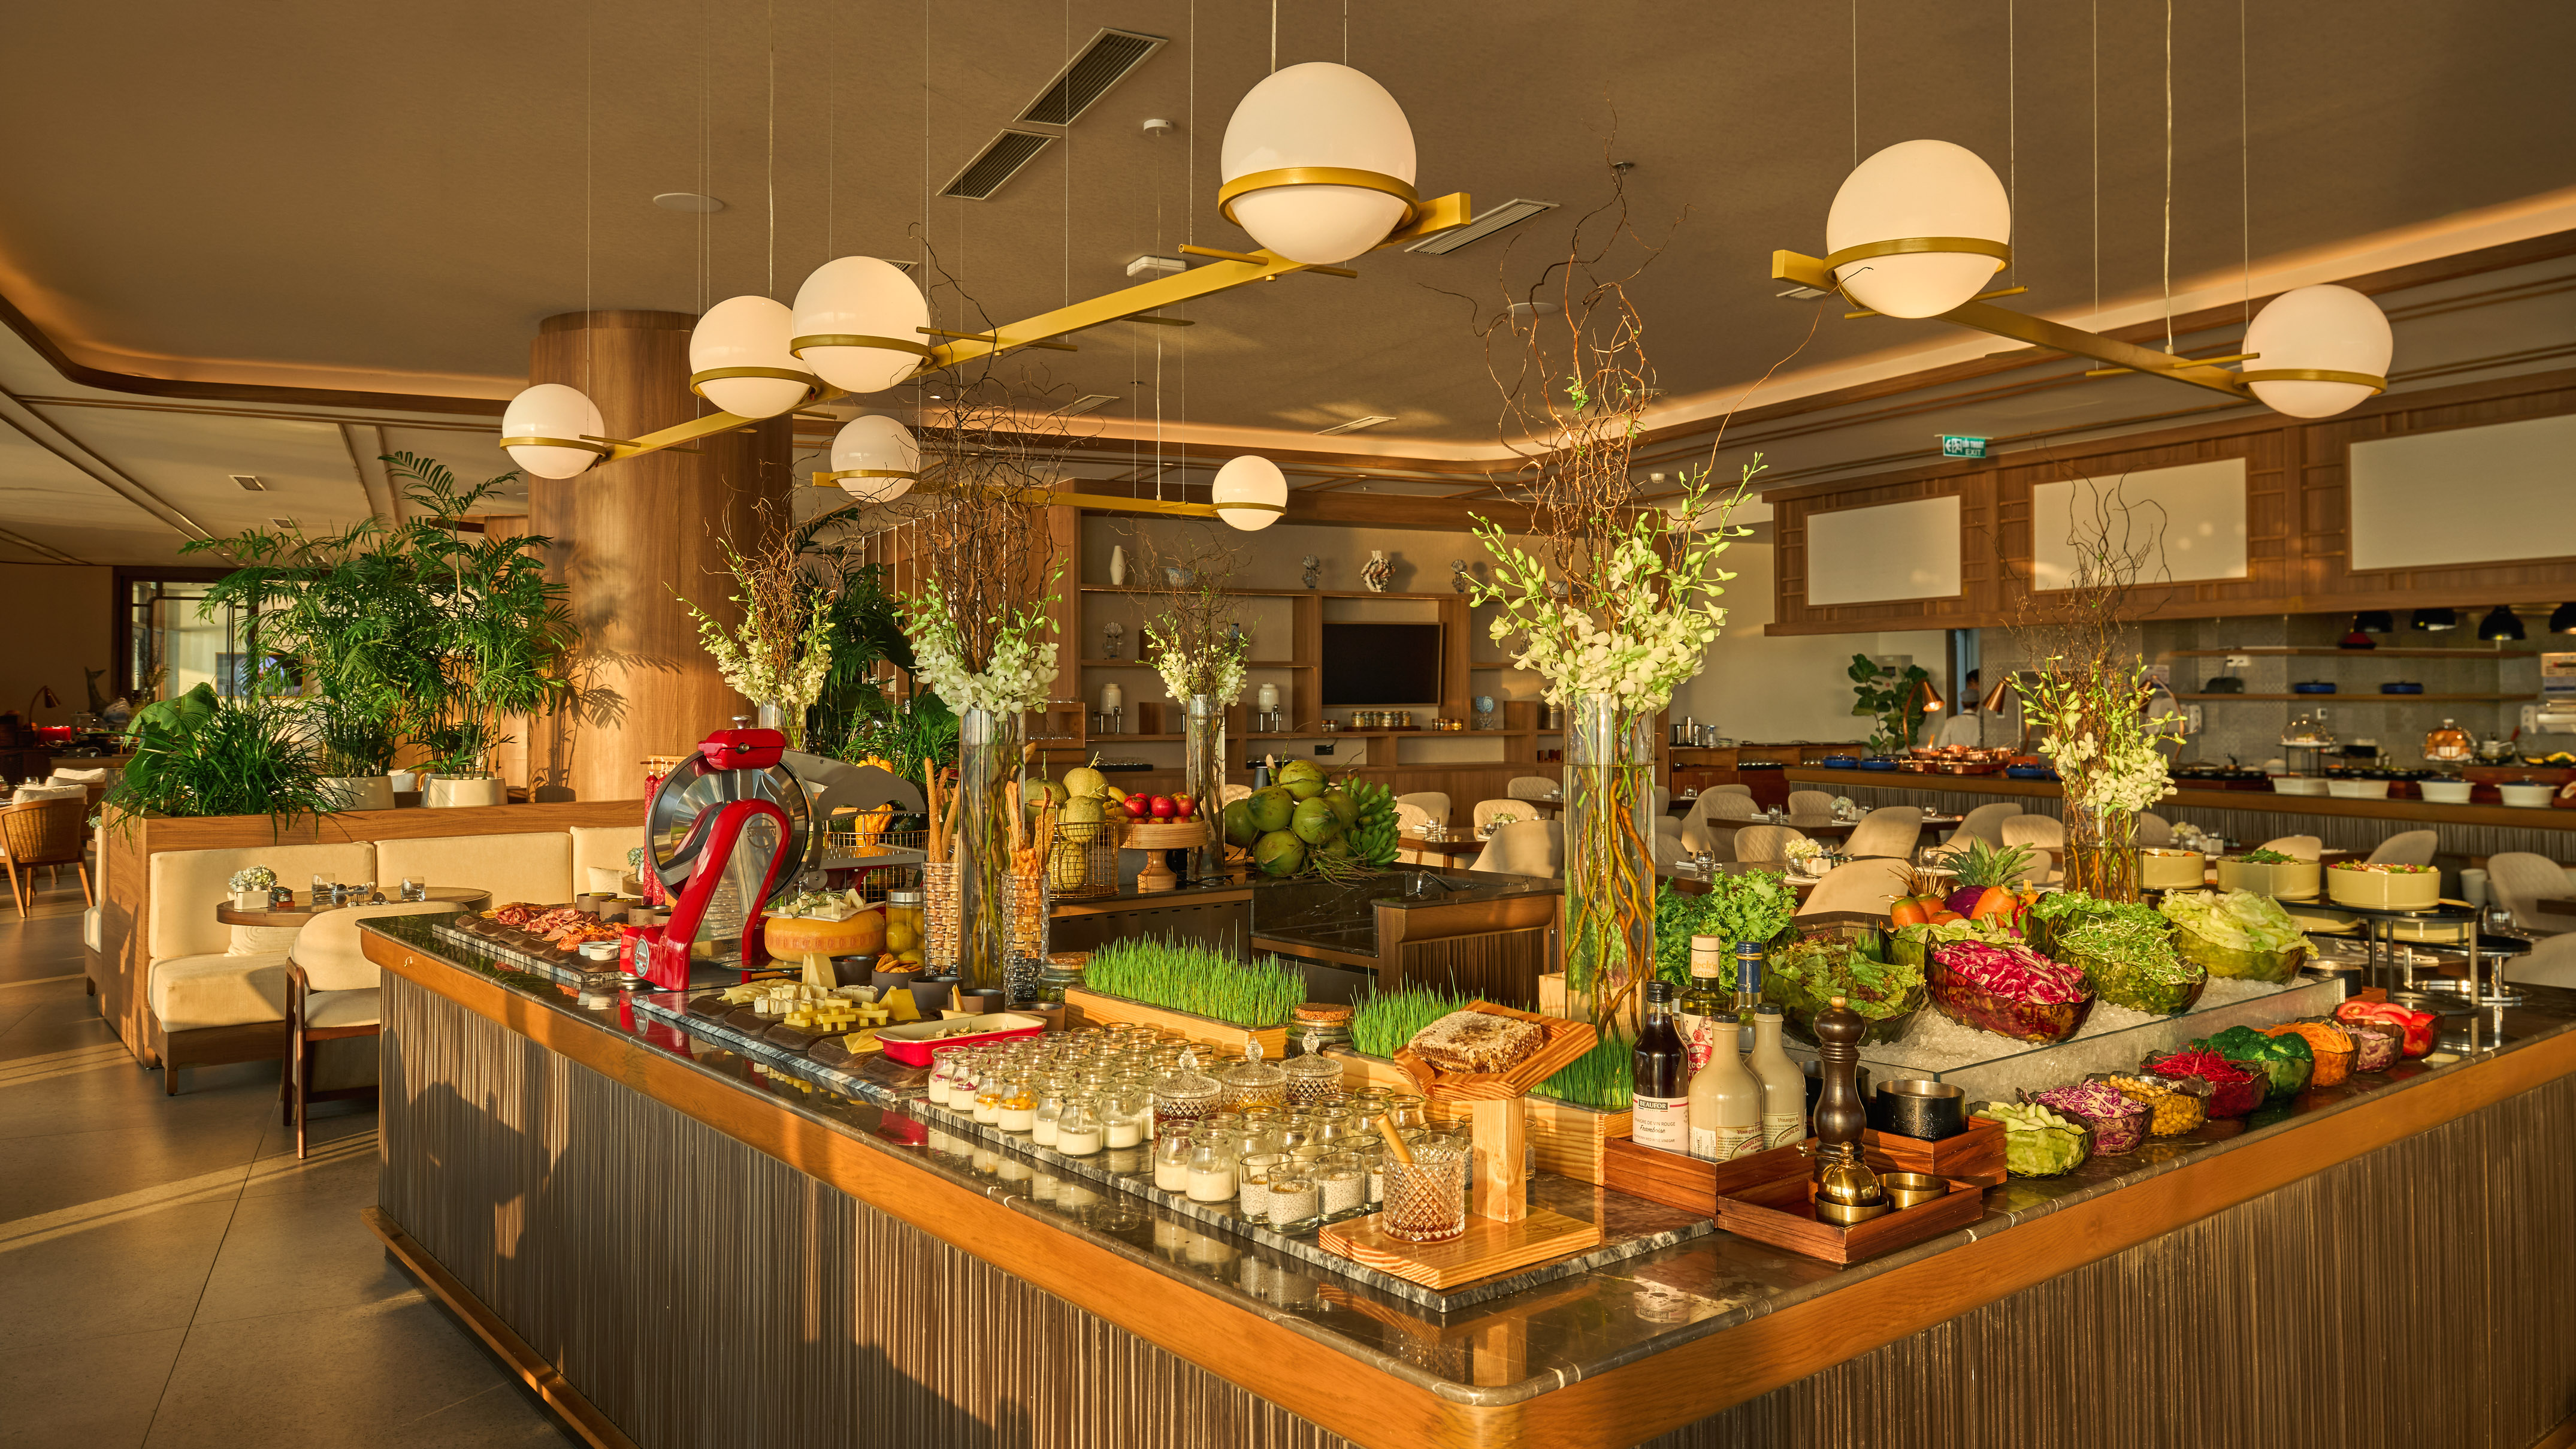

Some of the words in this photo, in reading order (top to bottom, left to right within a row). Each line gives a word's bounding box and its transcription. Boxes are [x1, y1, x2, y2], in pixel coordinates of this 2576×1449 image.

[1692, 960, 1718, 971] Rock'n
[1640, 1100, 1666, 1109] BEAUFOR
[1640, 1124, 1665, 1133] Framboise
[1778, 1129, 1795, 1143] VINAIGRE
[1739, 1139, 1755, 1151] VINAIGRE
